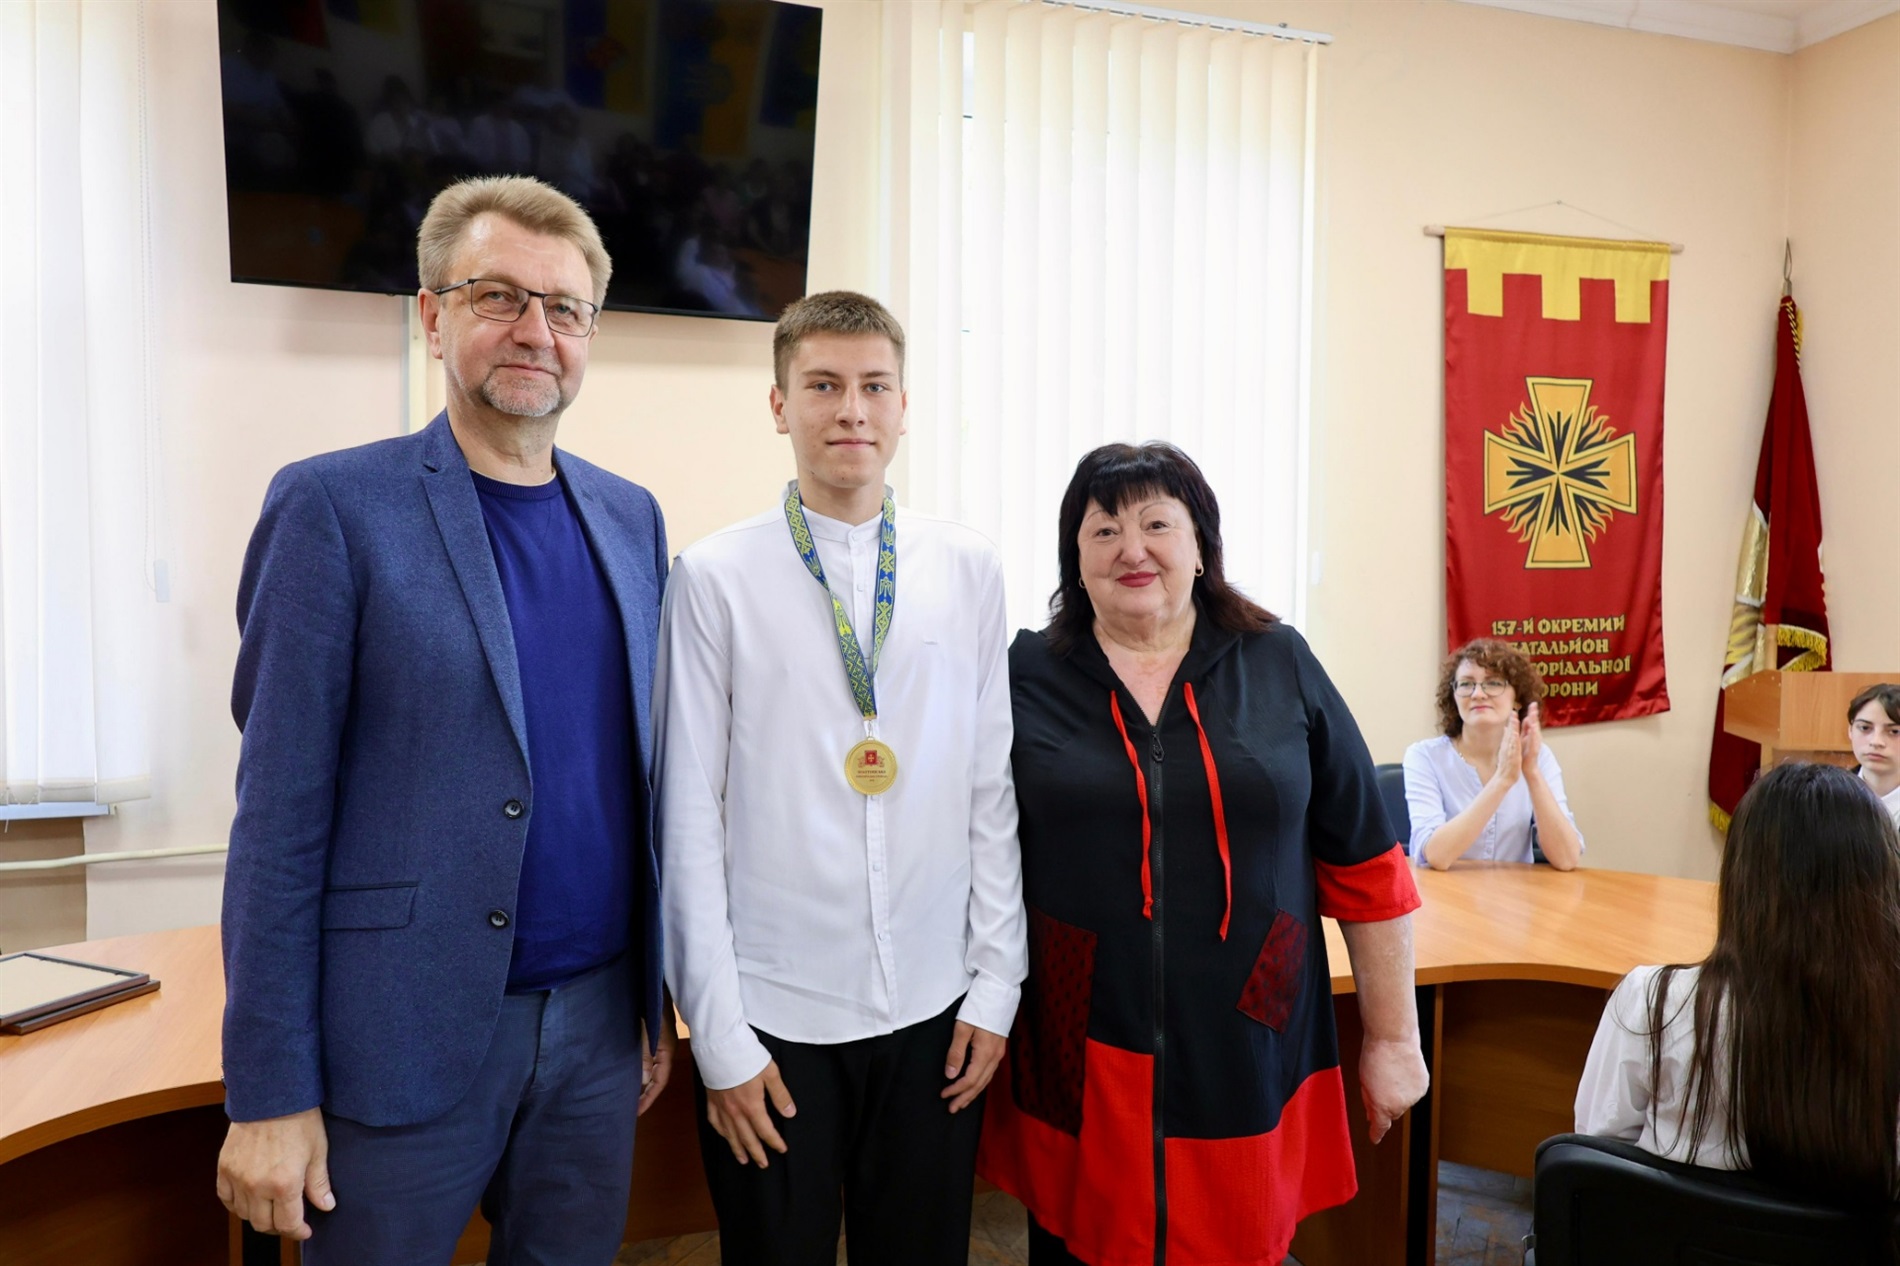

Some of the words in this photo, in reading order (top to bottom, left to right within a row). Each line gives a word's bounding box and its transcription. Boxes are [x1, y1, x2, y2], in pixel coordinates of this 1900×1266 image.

[1492, 617, 1534, 635] 157-Й
[1537, 614, 1625, 635] ОКРЕМИЙ
[1540, 681, 1598, 698] ОРОНИ
